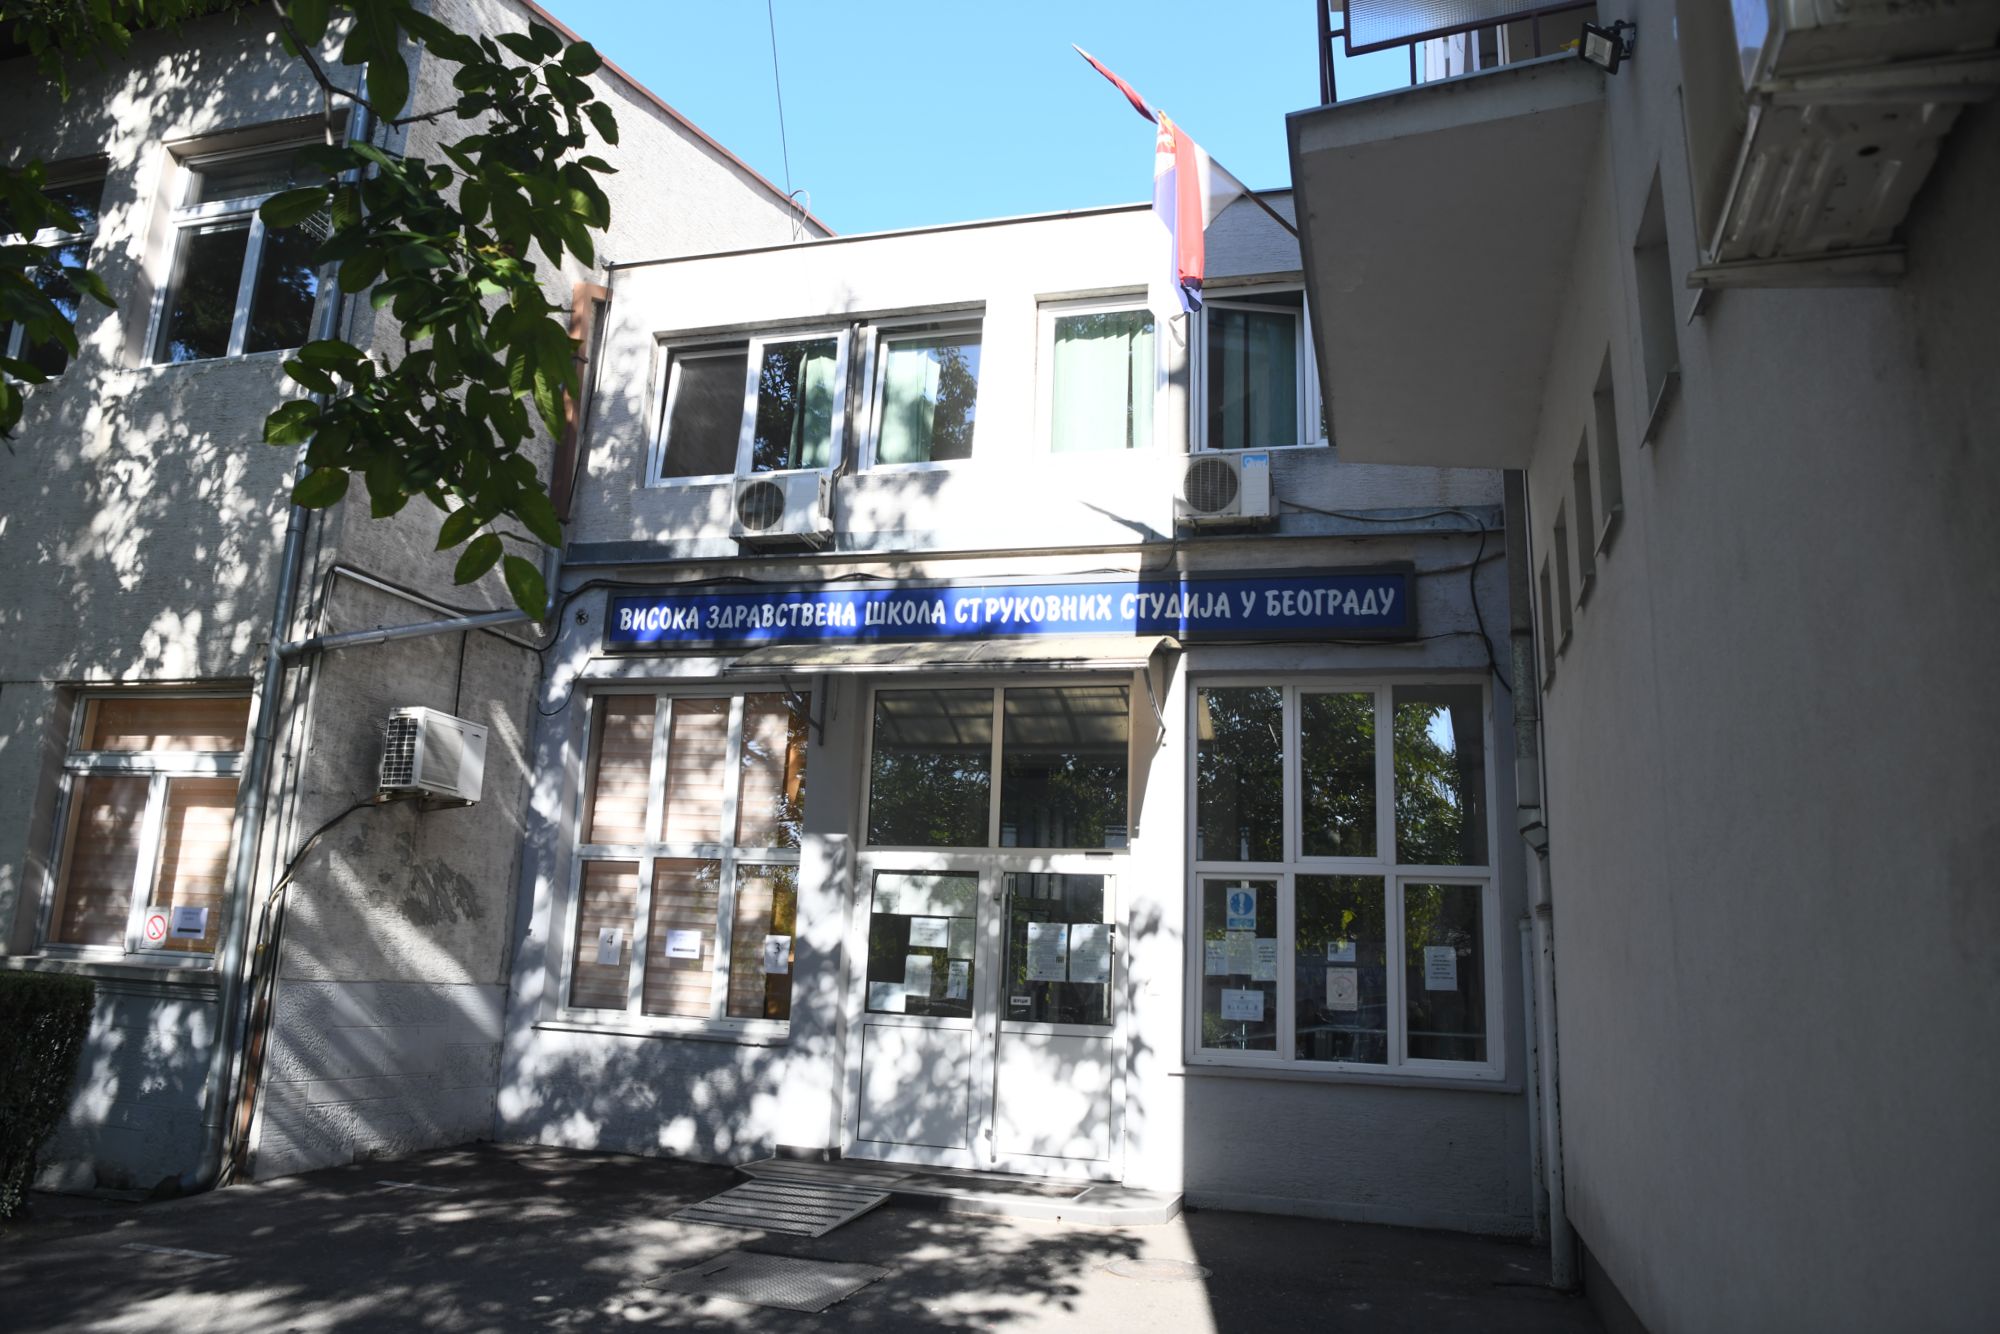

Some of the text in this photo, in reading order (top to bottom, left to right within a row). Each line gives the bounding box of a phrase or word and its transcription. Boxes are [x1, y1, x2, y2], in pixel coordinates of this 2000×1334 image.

[620, 587, 1395, 631] ВИСОКА ЗДРАВСТВЕНА ШКОЛА СТРУКОВНИХ СТУДИЈА У БЕОГРАДУ
[606, 934, 614, 946] 4
